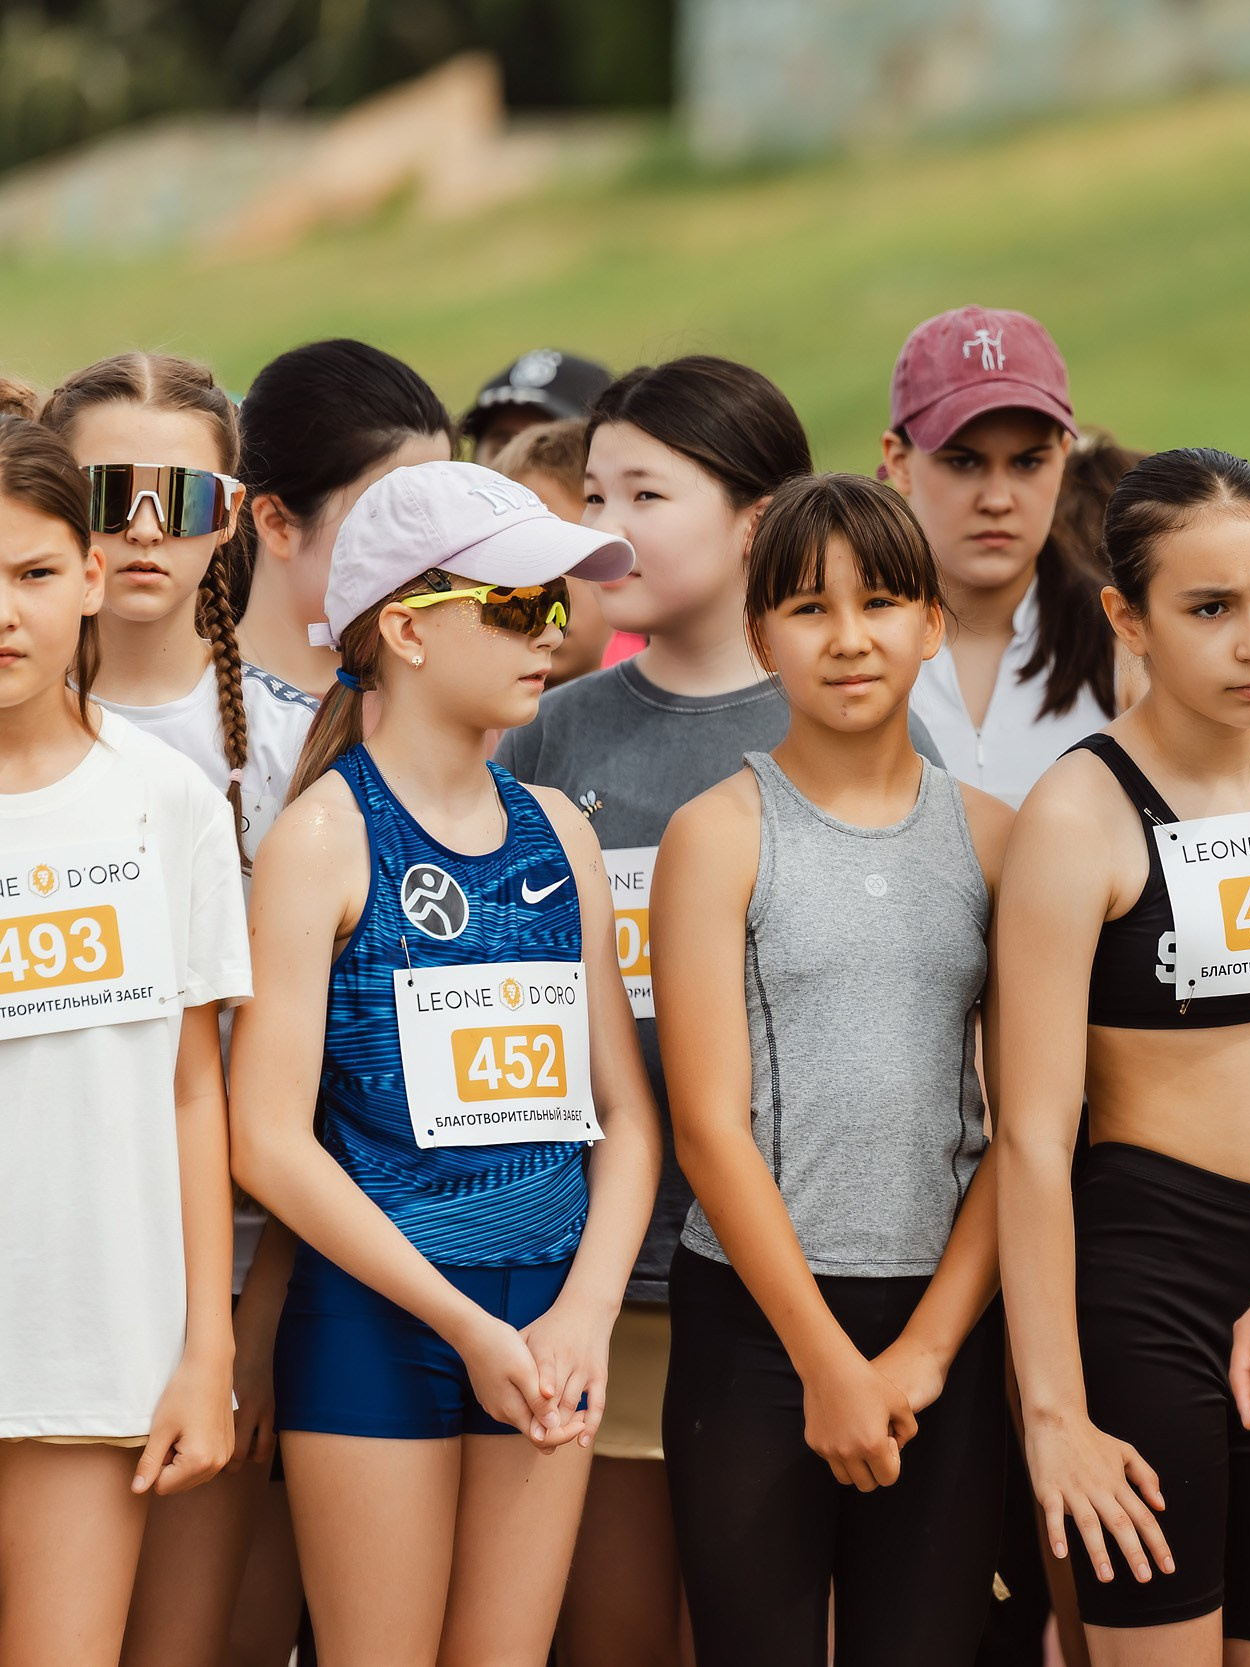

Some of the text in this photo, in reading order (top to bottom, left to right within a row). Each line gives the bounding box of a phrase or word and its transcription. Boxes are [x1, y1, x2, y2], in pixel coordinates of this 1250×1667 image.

[67, 861, 141, 888] D'ORO
[0, 916, 108, 983] 493
[0, 986, 154, 1019] ТВОРИТЕЛЬНЫЙ ЗАБЕГ
[416, 985, 576, 1012] LEONE D'ORO
[468, 1034, 560, 1090] 452
[435, 1107, 582, 1128] БЛАГОТВОРИТЕЛЬНЫЙ ЗАБЕГ
